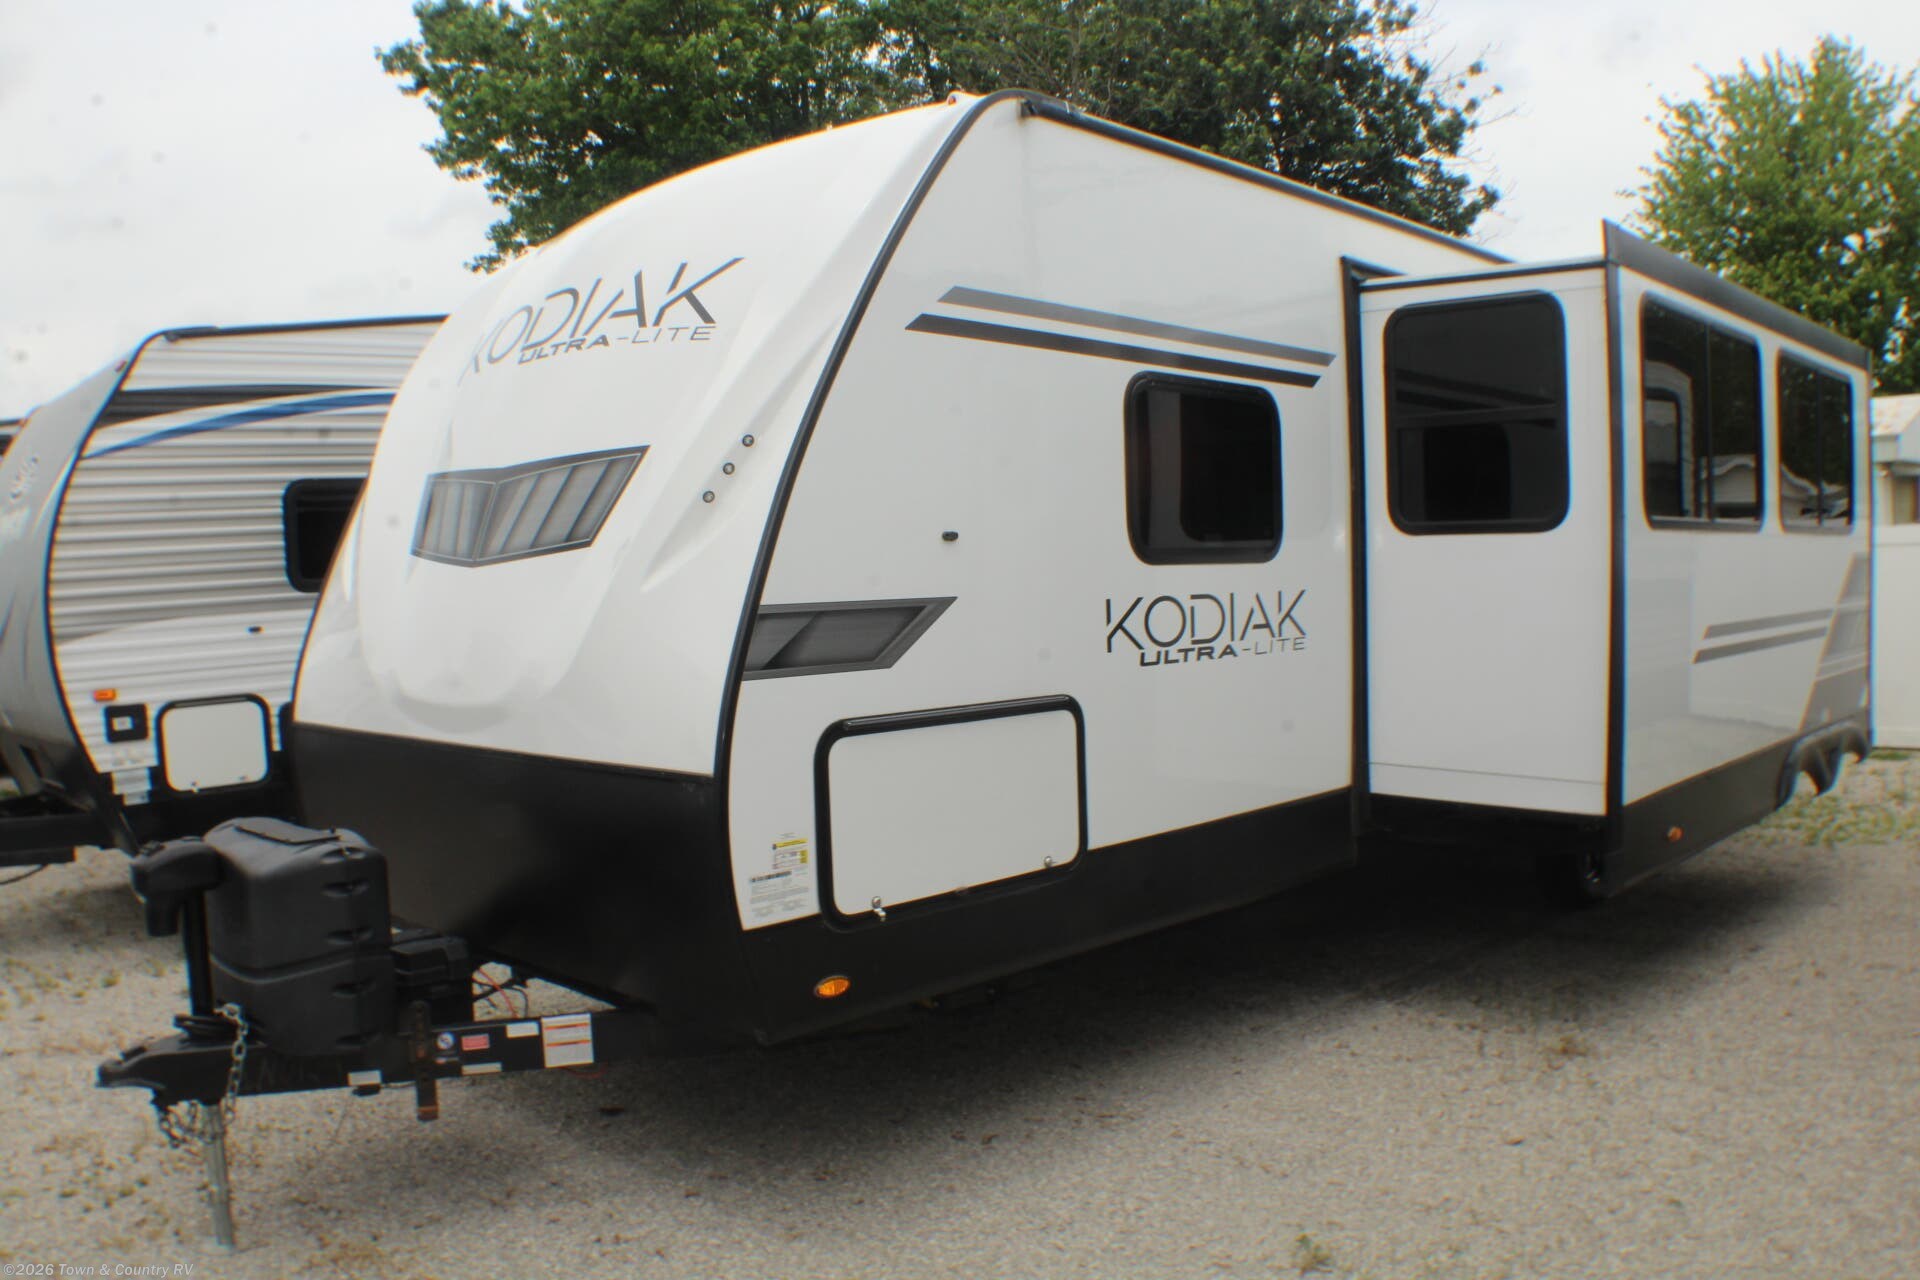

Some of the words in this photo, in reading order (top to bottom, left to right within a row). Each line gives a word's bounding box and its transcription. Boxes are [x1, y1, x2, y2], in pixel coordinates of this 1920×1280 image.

[457, 257, 745, 386] KODIAK
[517, 326, 716, 365] ULTRA-LITE
[1106, 589, 1306, 653] KODIAK
[1139, 637, 1306, 667] ULTRA-LITE
